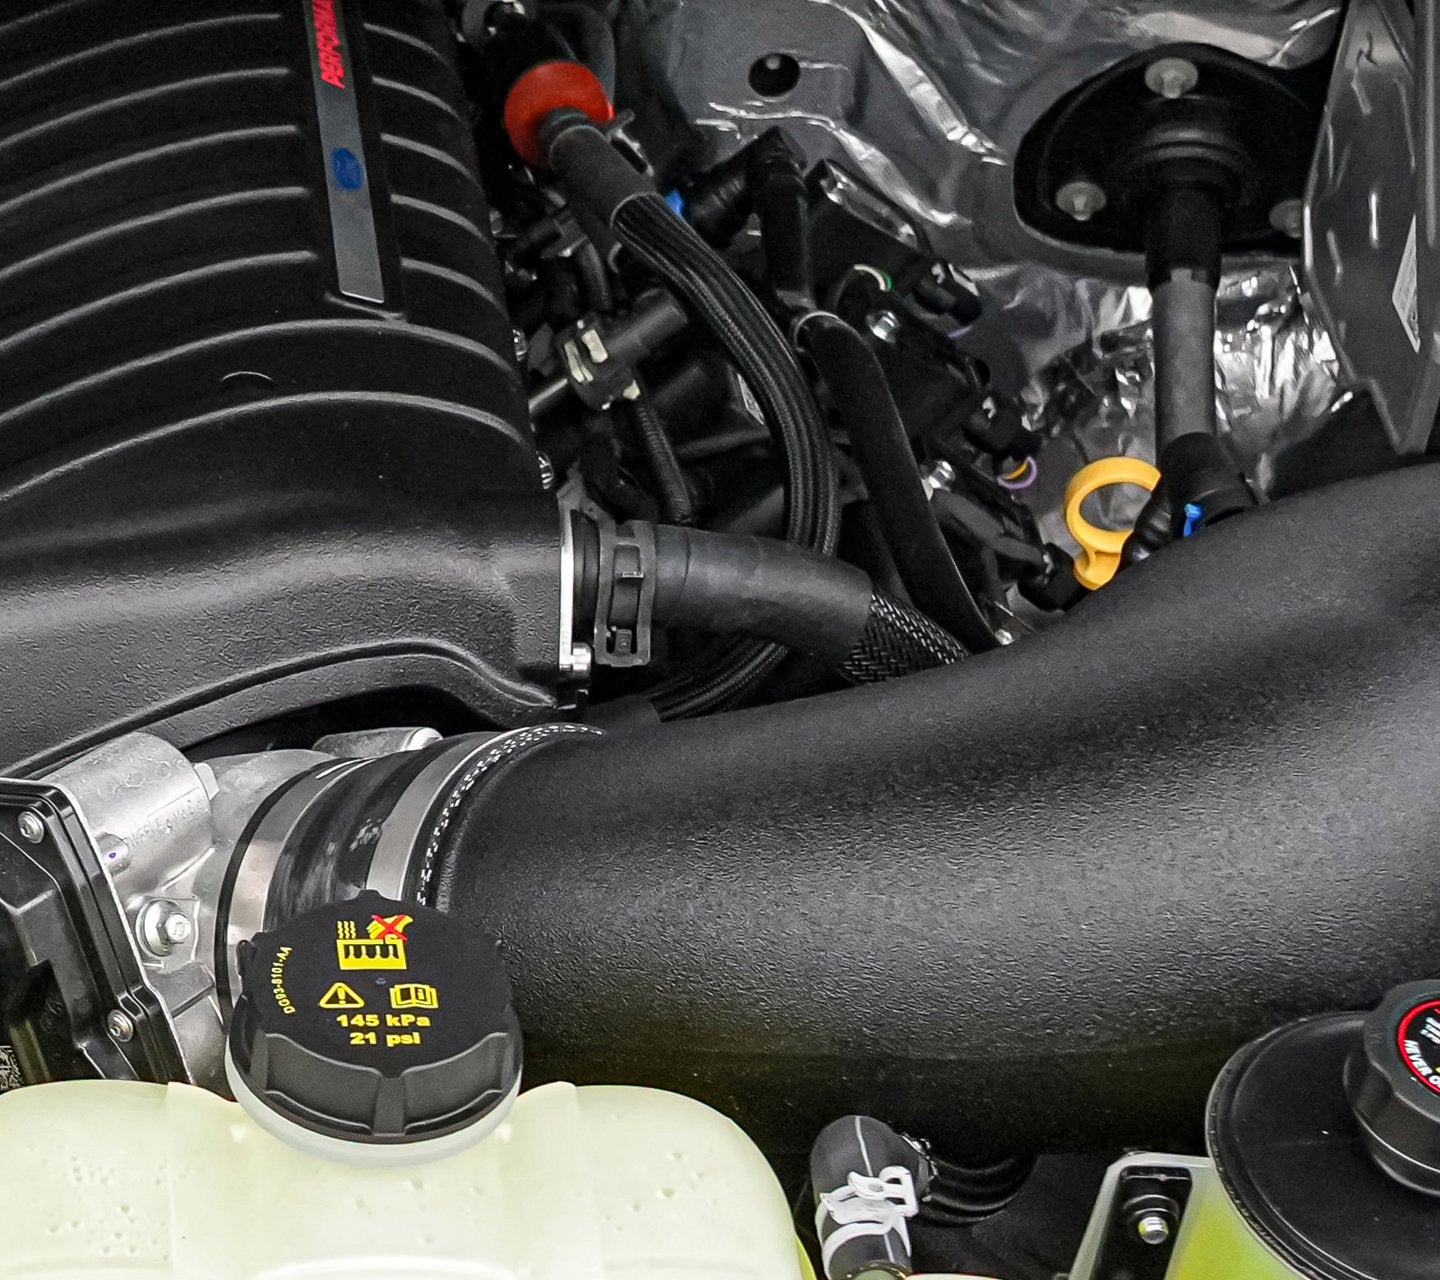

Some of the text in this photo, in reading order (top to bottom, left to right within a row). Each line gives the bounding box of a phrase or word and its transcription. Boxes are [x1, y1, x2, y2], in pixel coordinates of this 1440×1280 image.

[337, 1014, 431, 1028] 145 kPa
[350, 1032, 421, 1048] 21 psi
[1404, 1040, 1433, 1076] NEVER
